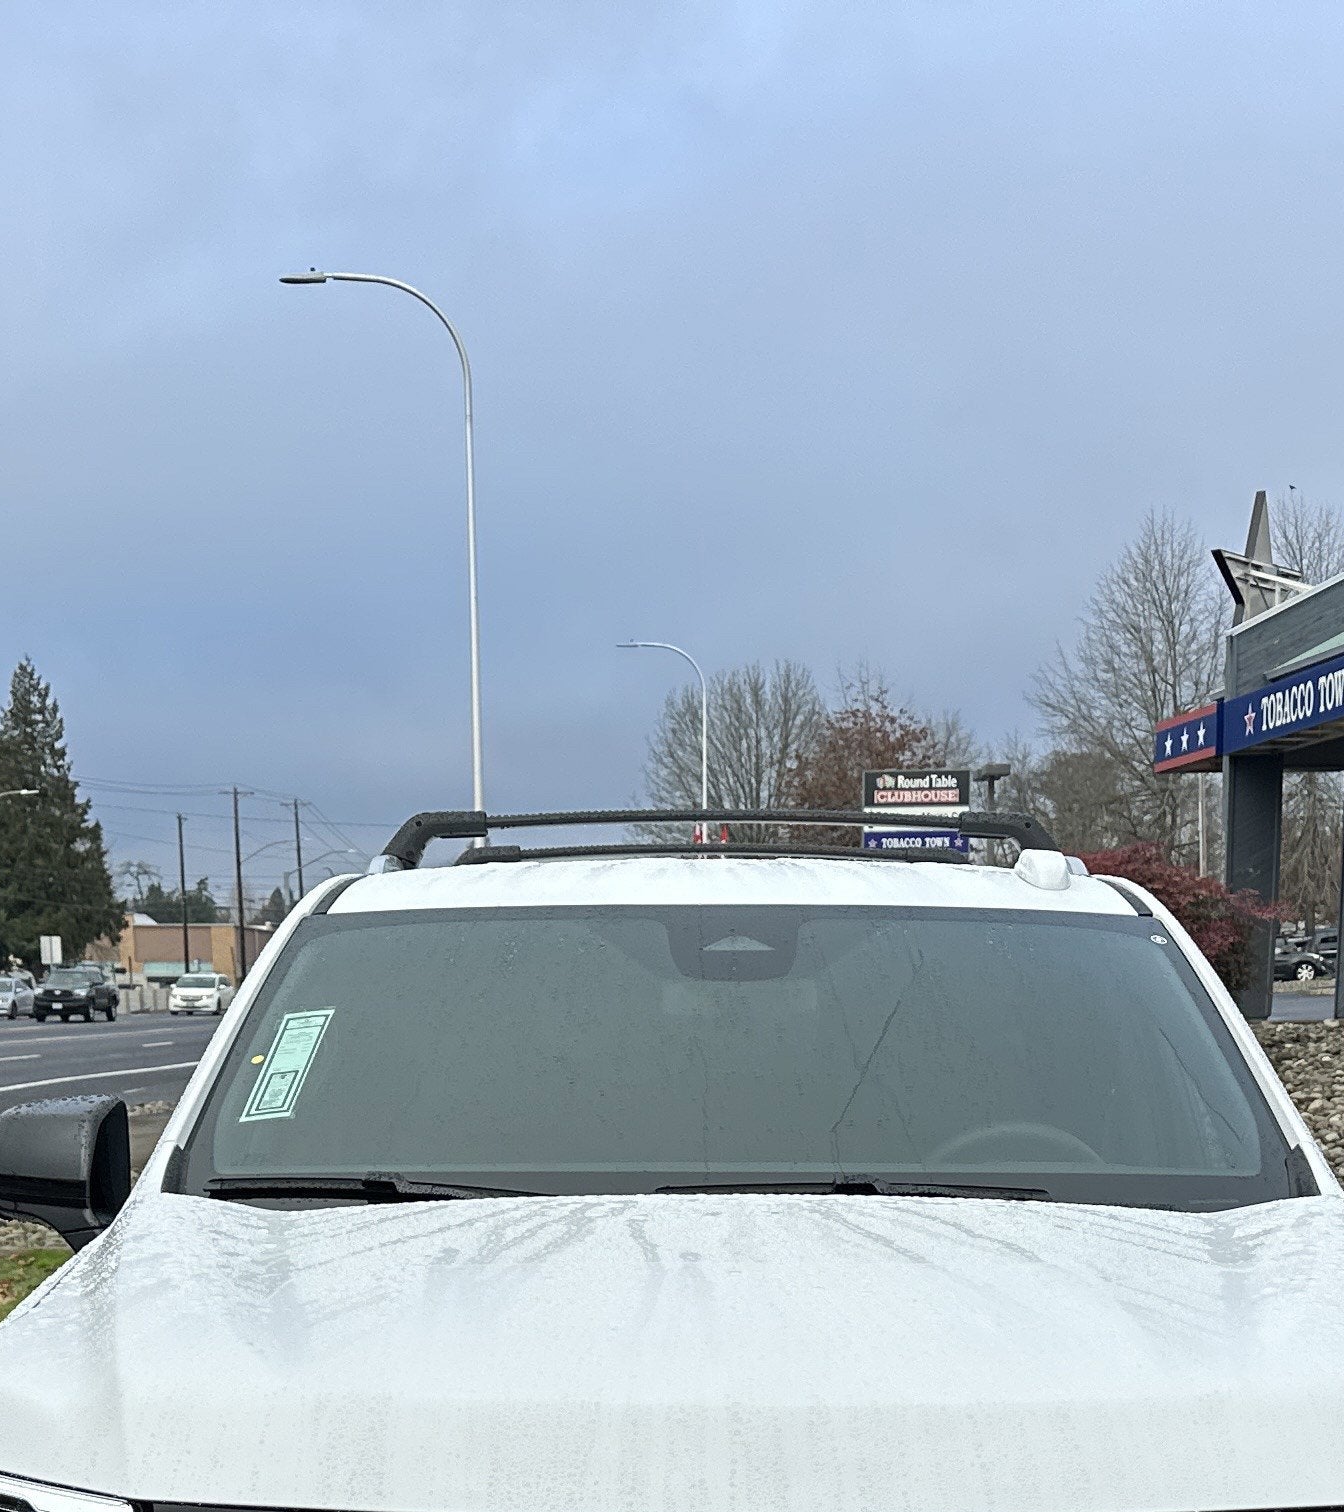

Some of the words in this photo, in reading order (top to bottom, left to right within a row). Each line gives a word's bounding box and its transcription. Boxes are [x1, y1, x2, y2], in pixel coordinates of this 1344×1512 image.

[1260, 680, 1315, 731] TOBACCO
[897, 774, 929, 788] Round
[930, 773, 957, 788] Table
[877, 789, 956, 803] CLUBHOUSE
[881, 837, 922, 848] TOBACCO
[924, 836, 950, 848] TOWN
